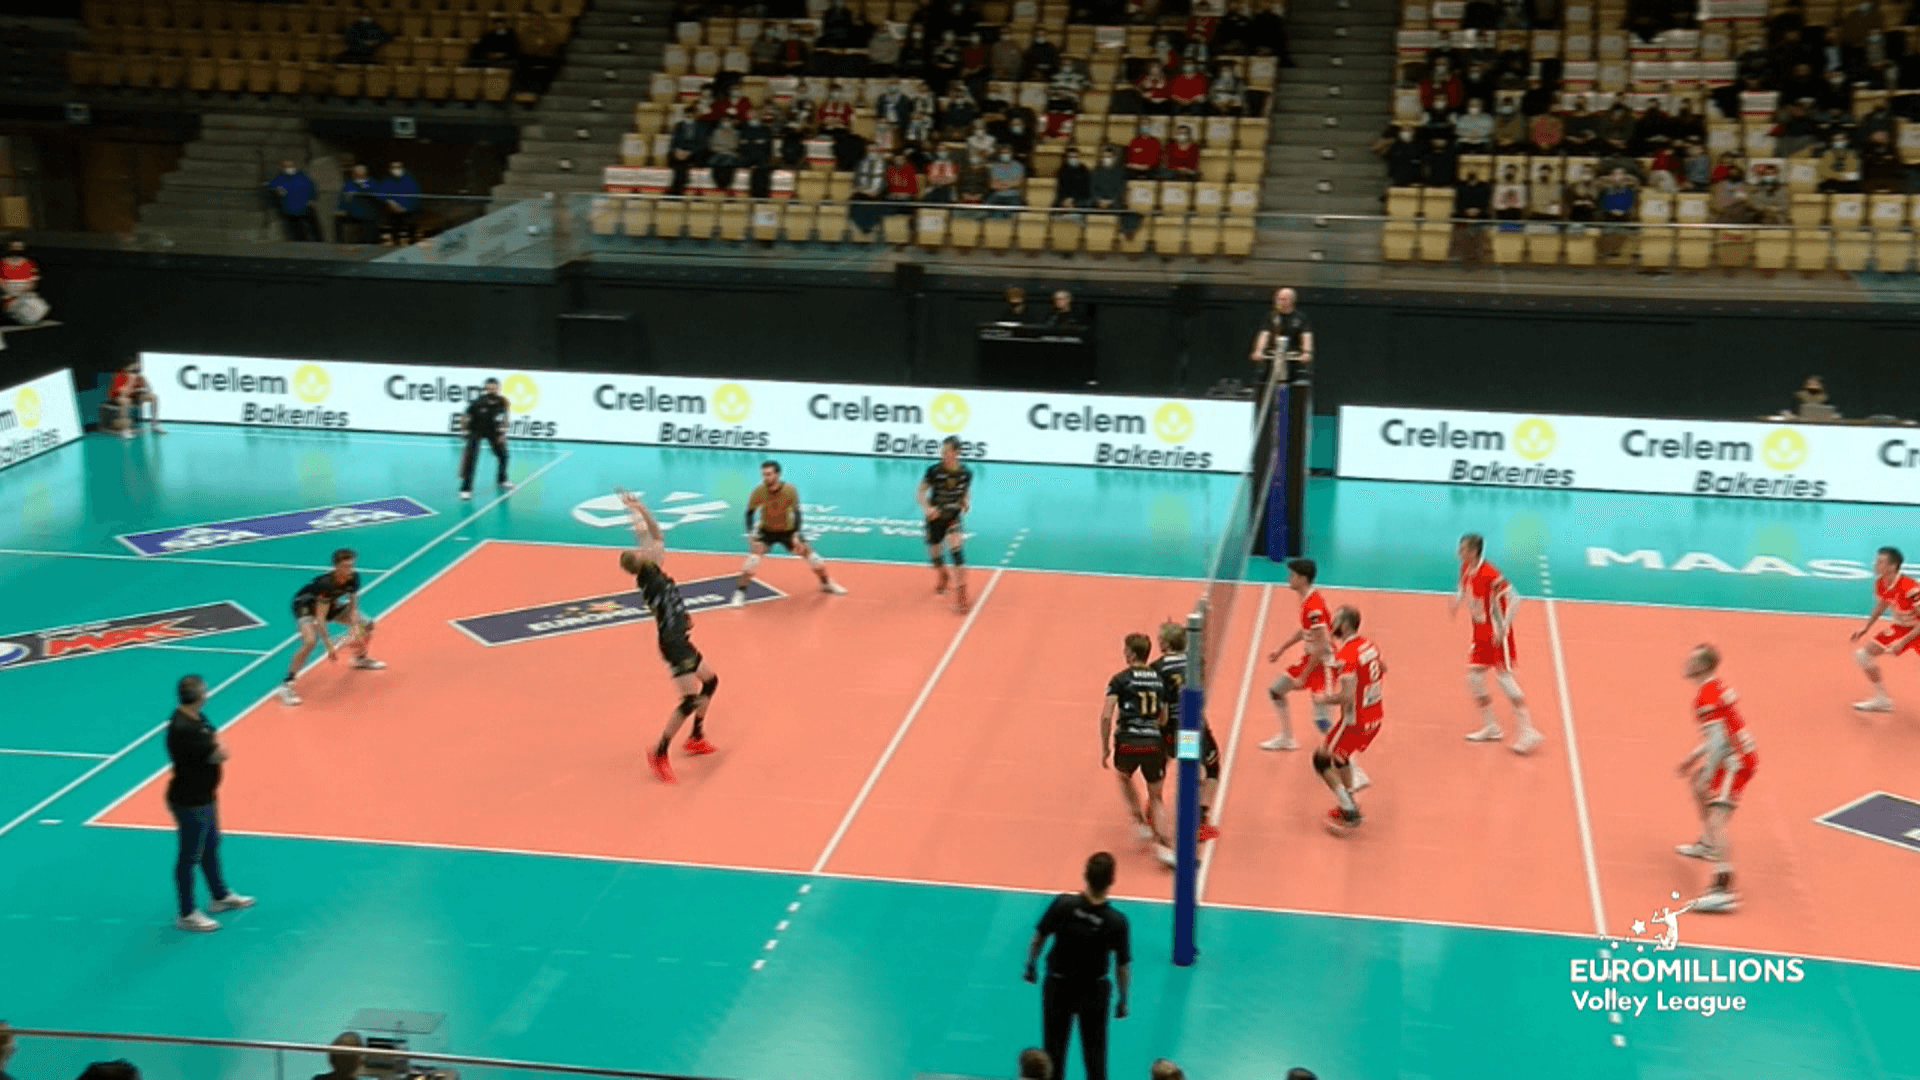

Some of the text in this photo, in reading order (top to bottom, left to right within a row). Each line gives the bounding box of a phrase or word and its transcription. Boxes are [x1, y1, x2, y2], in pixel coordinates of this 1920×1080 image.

[176, 364, 288, 395] Crelem
[594, 383, 706, 415] Crelem
[807, 393, 923, 424] Crelem
[241, 402, 349, 428] Bakeries
[1027, 403, 1146, 435] Crelem
[658, 422, 770, 448] Bakeries
[874, 431, 988, 459] Bakees
[1380, 418, 1505, 451] Crelem
[1620, 429, 1753, 462] Crelem
[1094, 441, 1212, 469] Bakeries
[1450, 459, 1576, 487] Bakeries
[1694, 470, 1829, 498] Bakeries
[1138, 690, 1157, 714] 11
